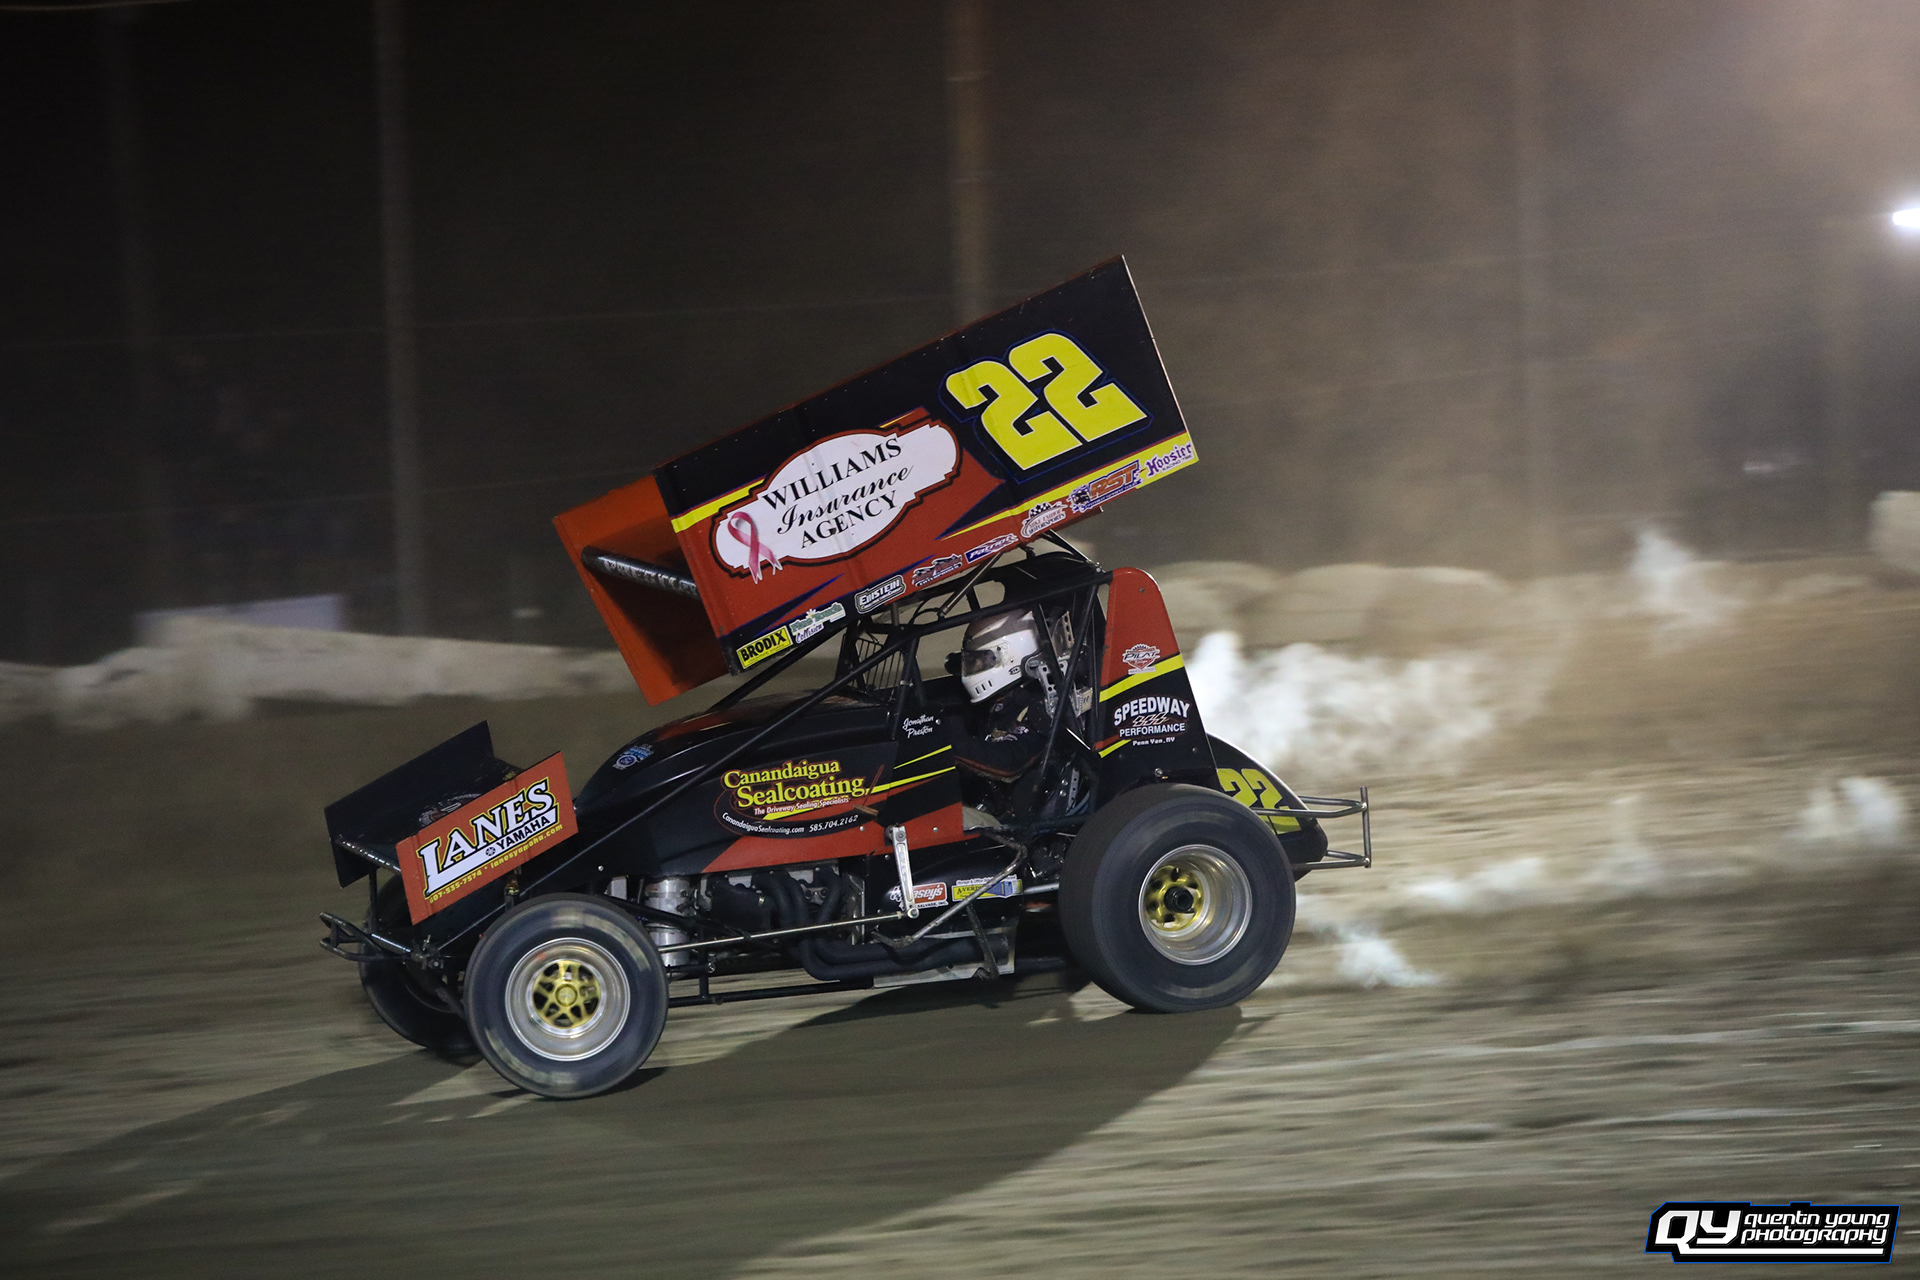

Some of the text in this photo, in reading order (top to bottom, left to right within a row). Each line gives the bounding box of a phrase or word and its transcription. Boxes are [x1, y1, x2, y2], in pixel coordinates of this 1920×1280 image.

[945, 332, 1148, 471] 22
[762, 437, 902, 511] WILLIAMS
[1145, 442, 1192, 477] Hoosier
[776, 465, 915, 535] Insurance
[801, 489, 897, 550] AGENCY
[740, 630, 787, 662] BRODIX
[1124, 651, 1156, 660] PILAT
[902, 714, 934, 730] Jonathan
[1113, 696, 1190, 726] SPEEDWAY
[906, 725, 933, 739] Preston
[1119, 722, 1186, 738] PERFORMANCE
[723, 759, 841, 788] Canandaigua
[754, 797, 850, 815] The Driveway Sealing Specialists
[1216, 767, 1302, 835] 22
[416, 777, 559, 898] LANES
[495, 815, 551, 850] YAMAHA
[722, 812, 859, 835] CanandaiguaSealcoating.com 585.704.2162
[490, 823, 563, 869] lanesyamaha.com
[912, 884, 944, 900] asey's
